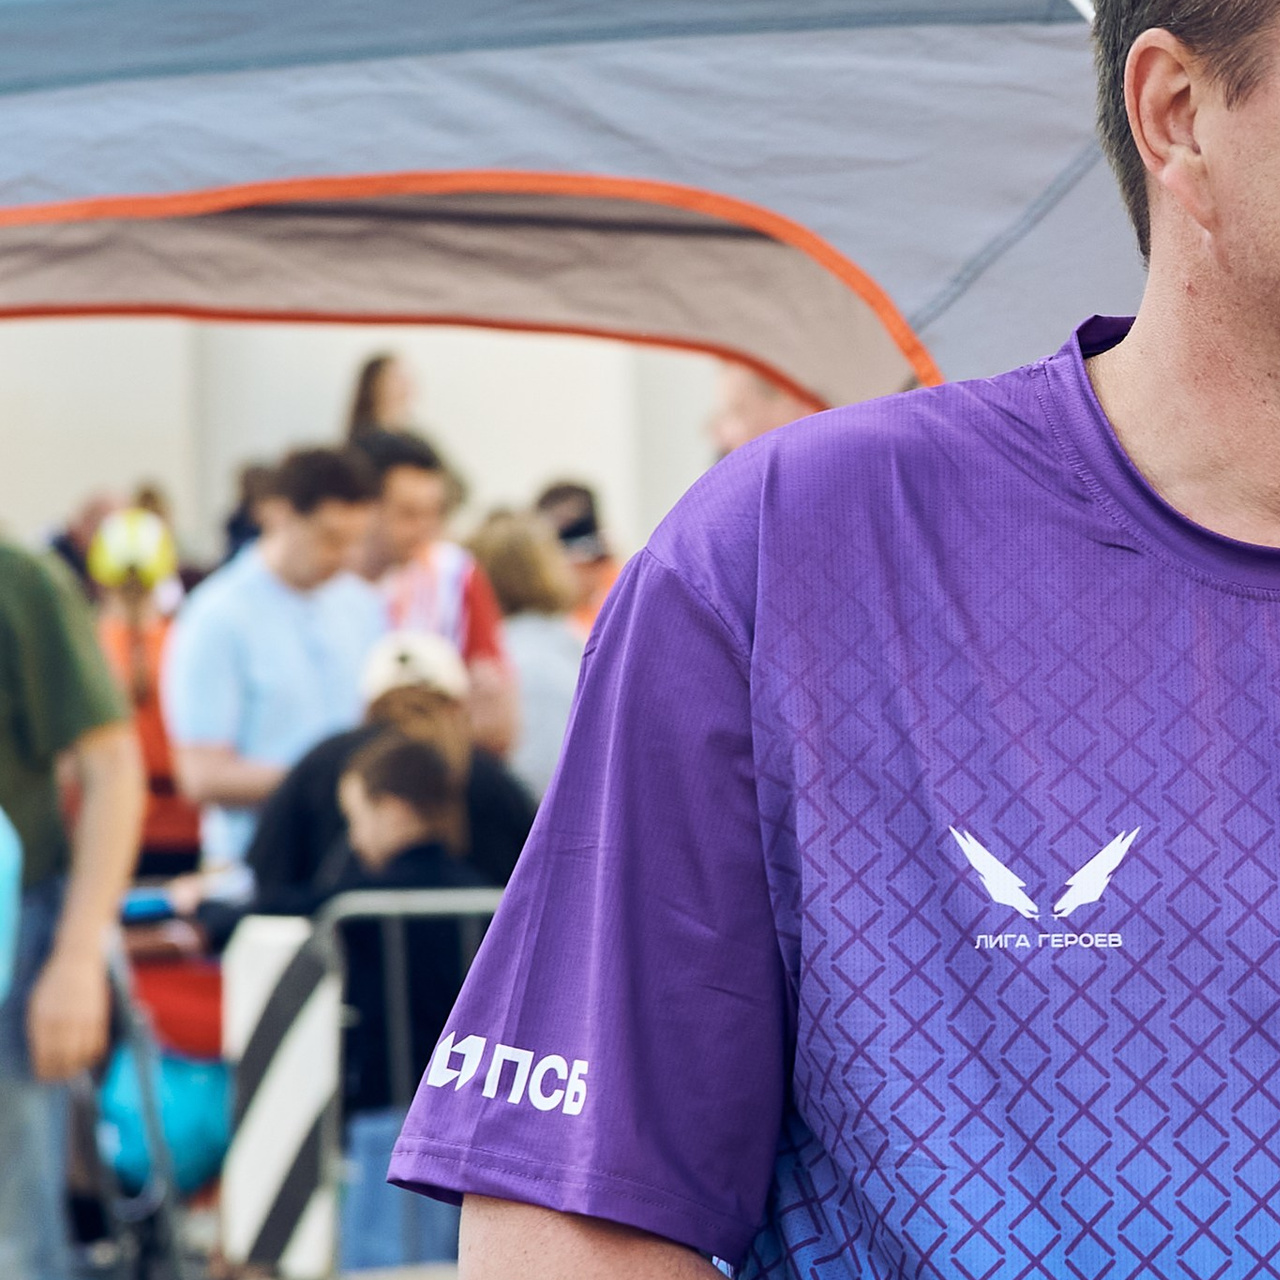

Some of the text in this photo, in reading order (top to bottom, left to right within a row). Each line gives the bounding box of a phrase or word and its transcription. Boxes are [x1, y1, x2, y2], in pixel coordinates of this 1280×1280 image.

[975, 933, 1123, 949] ЛИГА ГЕРОЕВ
[481, 1043, 589, 1116] ПСБ
